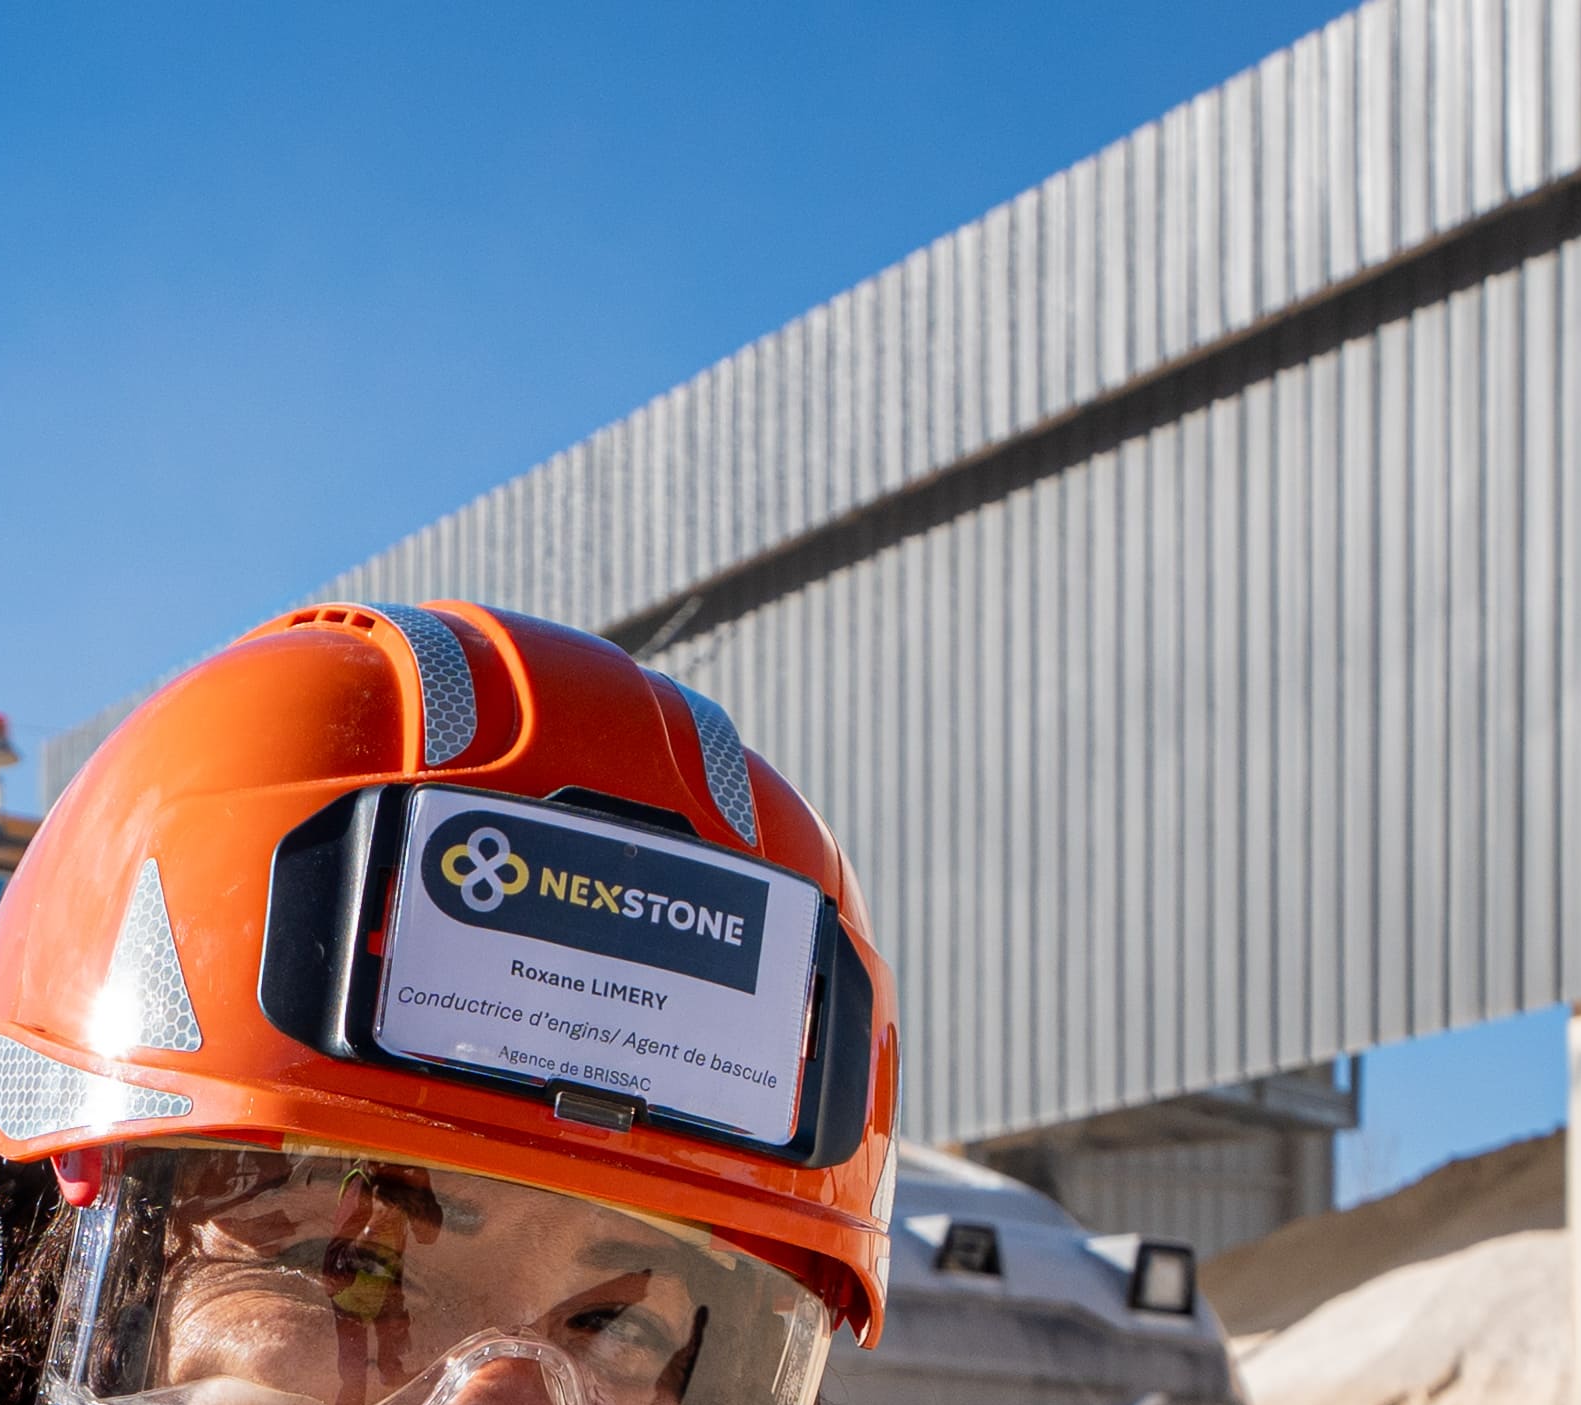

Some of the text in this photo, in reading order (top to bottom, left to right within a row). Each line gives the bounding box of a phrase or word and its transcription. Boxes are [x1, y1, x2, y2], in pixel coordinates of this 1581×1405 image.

[540, 867, 744, 946] NEXSTONE
[511, 960, 668, 1011] Roxane LIMERY
[398, 986, 523, 1022] Conductrice
[622, 1031, 680, 1059] Agent
[683, 1048, 706, 1066] de
[710, 1053, 778, 1089] bascule
[498, 1045, 652, 1092] Agence de BRISSAC
